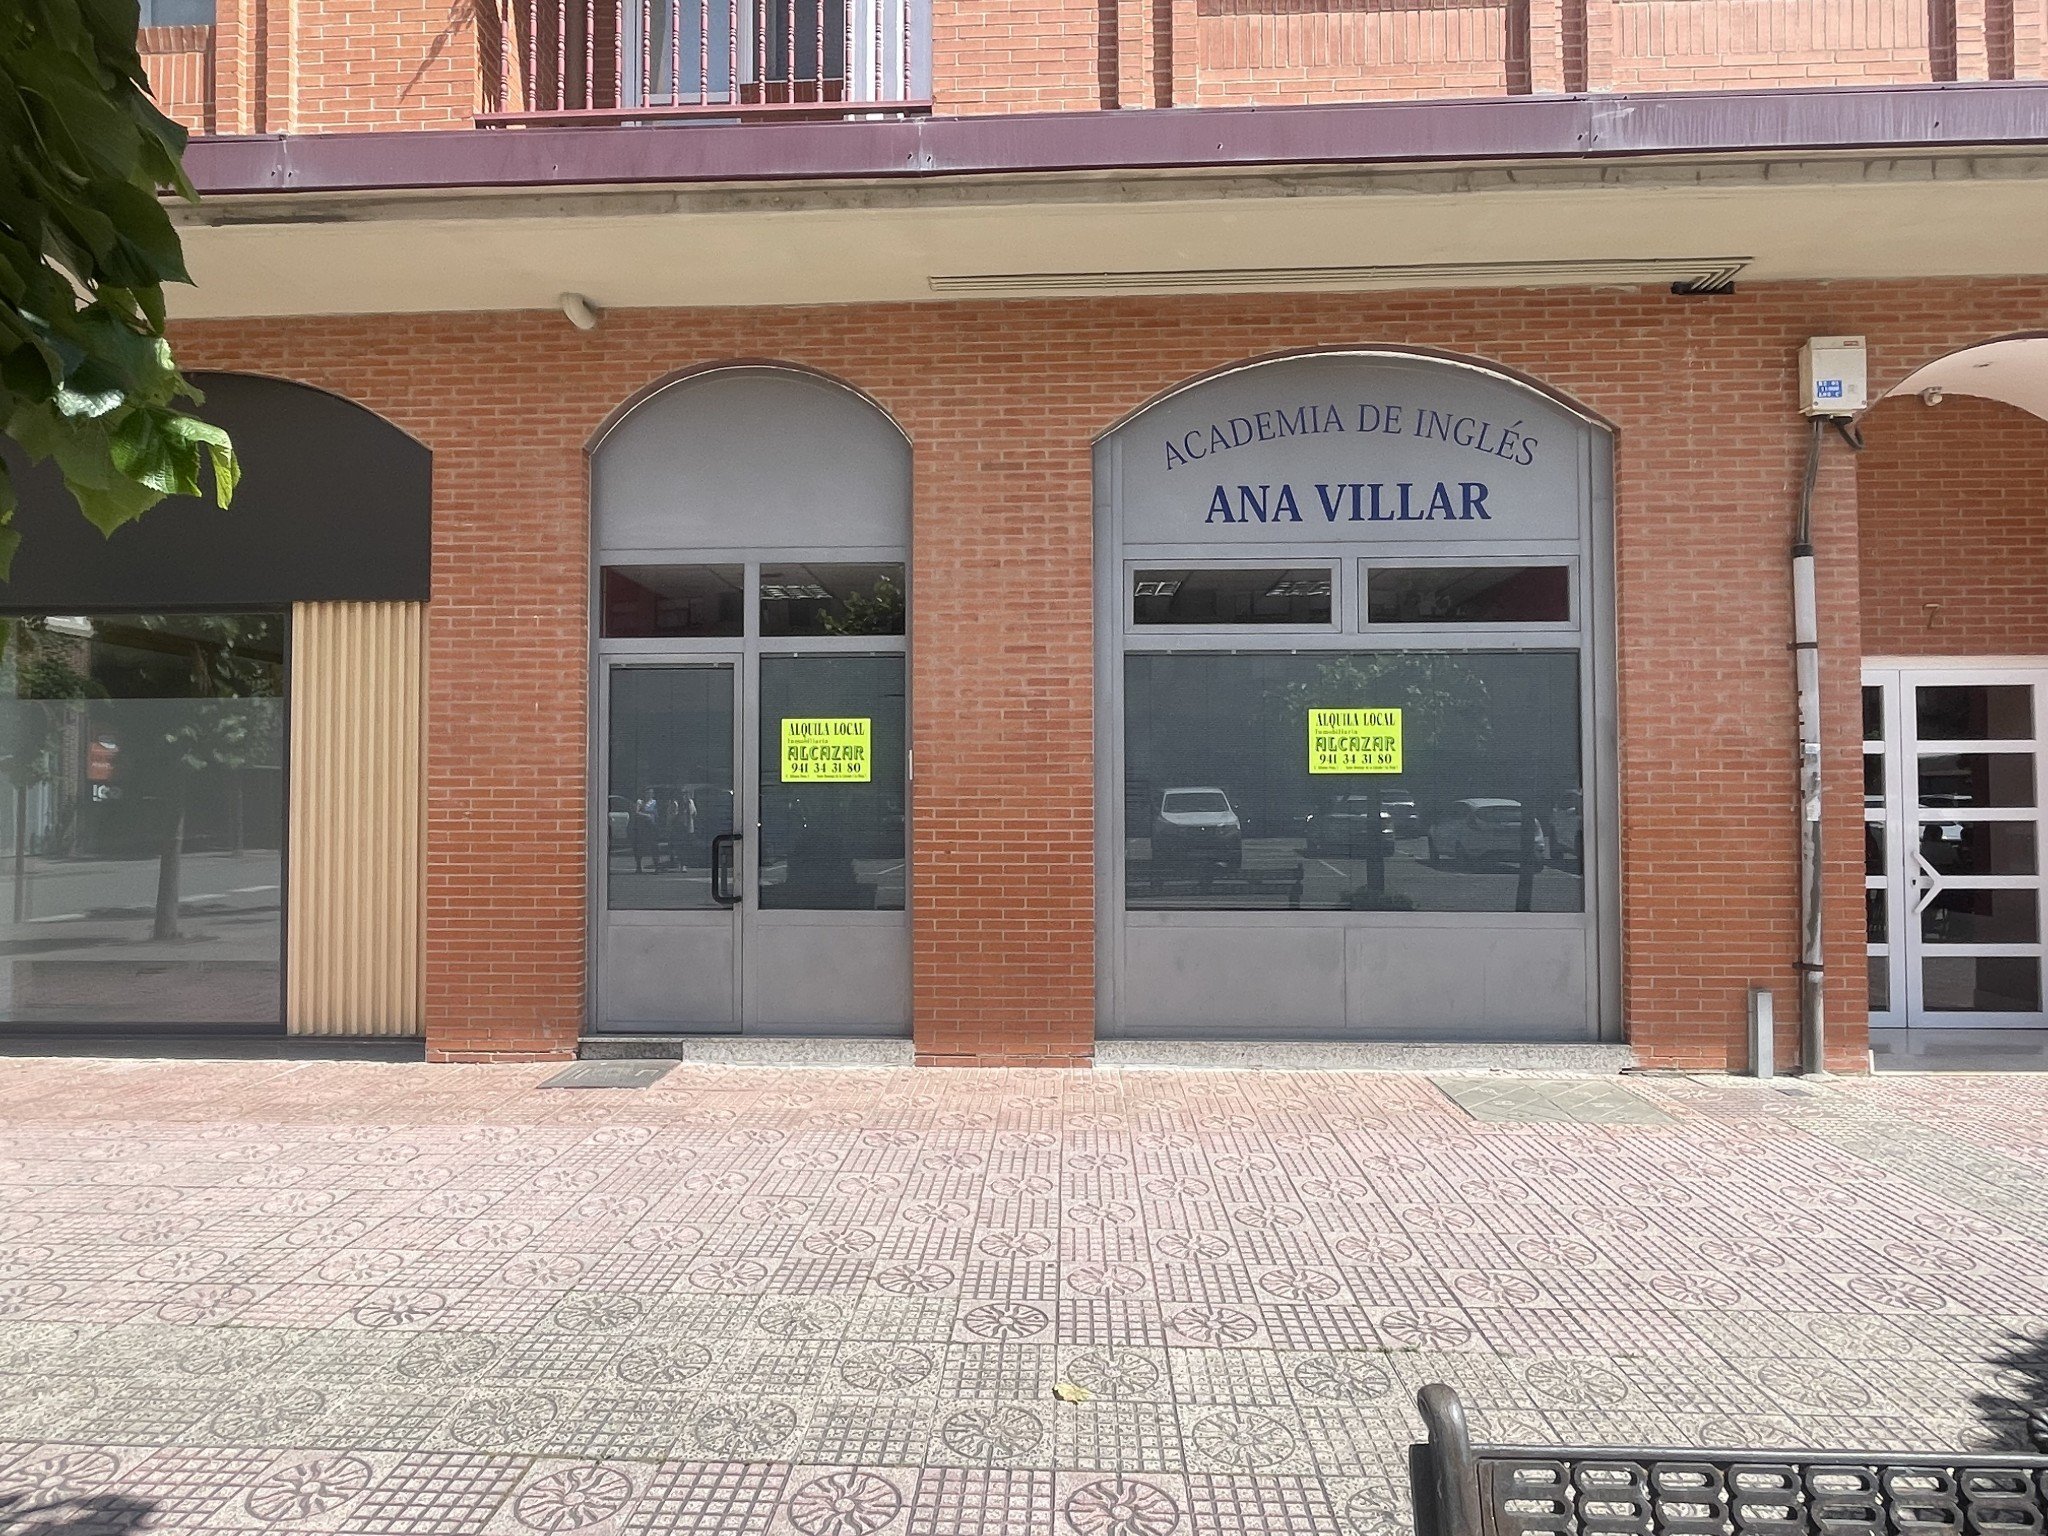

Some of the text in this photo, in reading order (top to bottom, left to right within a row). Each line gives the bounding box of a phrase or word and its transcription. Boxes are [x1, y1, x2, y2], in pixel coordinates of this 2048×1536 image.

[1164, 403, 1539, 471] ACADEMIA DE INGLÉS
[1205, 481, 1492, 524] ANA VILLAR
[1315, 712, 1395, 728] ALQUILA LOCAL
[788, 722, 865, 737] ALQUILA LOCAL
[1315, 736, 1396, 752] ALCAZAR
[787, 745, 865, 761] ALCAZAR
[1319, 753, 1392, 764] 941 34 31 80
[791, 762, 861, 773] 941 34 31 80
